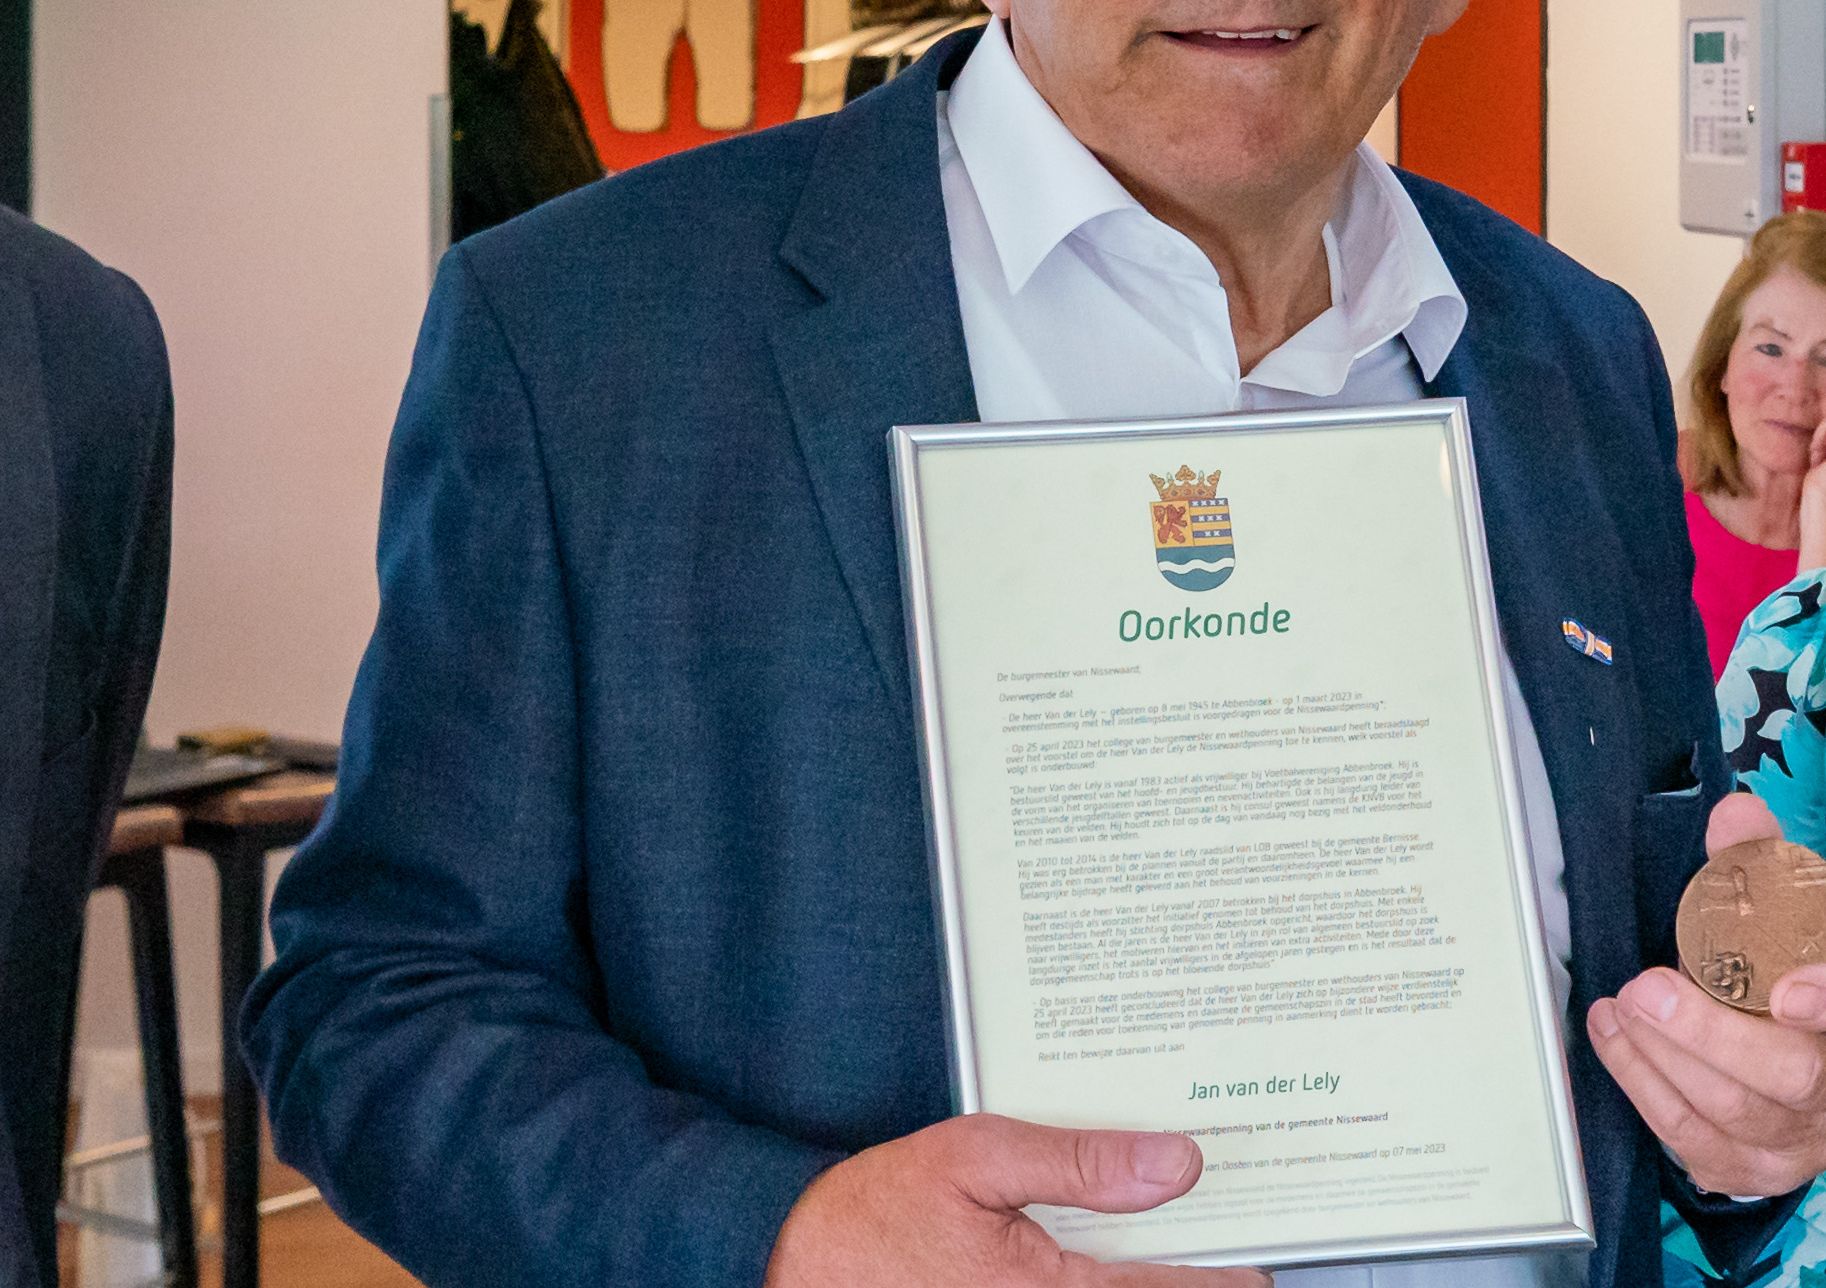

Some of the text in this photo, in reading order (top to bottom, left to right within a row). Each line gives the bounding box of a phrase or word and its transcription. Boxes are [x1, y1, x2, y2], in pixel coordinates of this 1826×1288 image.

[1119, 601, 1291, 643] Oorkonde
[997, 672, 1008, 681] De
[999, 691, 1056, 702] Overwegende
[1008, 713, 1020, 721] De
[1023, 712, 1042, 720] heer
[1045, 711, 1060, 719] Van
[1063, 710, 1076, 718] der
[1080, 708, 1097, 718] Lely
[1110, 706, 1145, 717] geboren
[1148, 705, 1158, 714] op
[1162, 703, 1167, 712] 8
[1189, 700, 1208, 710] 1945
[1222, 697, 1272, 707] Abbenbroek
[1282, 697, 1293, 706] op
[1303, 694, 1327, 702] maart
[1330, 691, 1351, 701] 2023
[1082, 717, 1098, 726] met
[1101, 716, 1115, 725] het
[1284, 705, 1294, 714] de
[1012, 743, 1023, 753] Op
[1027, 742, 1037, 751] 25
[1040, 742, 1059, 751] april
[1062, 740, 1083, 749] 2023
[1087, 739, 1100, 747] het
[1103, 738, 1133, 747] college
[1228, 728, 1278, 738] wethouders
[1298, 723, 1346, 733] Nissewaard
[1349, 721, 1370, 730] heeft
[1027, 753, 1040, 761] het
[1044, 751, 1077, 760] voorstel
[1096, 749, 1107, 757] de
[1110, 746, 1128, 756] heer
[1131, 747, 1147, 755] Van
[1150, 746, 1164, 754] der
[1167, 743, 1184, 754] Lely
[1285, 737, 1298, 745] toe
[1302, 736, 1309, 744] te
[1348, 732, 1366, 741] welk
[1369, 729, 1402, 739] voorstel
[1405, 729, 1417, 737] als
[1006, 764, 1028, 775] volgt
[1027, 785, 1046, 793] heer
[1049, 783, 1065, 791] Van
[1068, 782, 1081, 790] der
[1085, 781, 1102, 790] Lely
[1114, 778, 1137, 787] vanaf
[1141, 776, 1161, 785] 1983
[1164, 774, 1188, 784] actief
[1191, 774, 1202, 782] als
[1251, 770, 1261, 780] bij
[1398, 760, 1409, 770] Hij
[1017, 859, 1033, 868] Van
[1036, 857, 1057, 866] 2010
[1060, 856, 1072, 864] tot
[1076, 854, 1096, 864] 2014
[1110, 853, 1119, 861] de
[1122, 852, 1141, 860] heer
[1163, 849, 1176, 858] der
[1180, 848, 1197, 857] Lely
[1200, 844, 1233, 855] raadslid
[1254, 842, 1270, 851] LOB
[1274, 839, 1308, 852] geweest
[1311, 839, 1322, 849] bij
[1324, 838, 1335, 847] de
[1338, 835, 1380, 848] gemeente
[1040, 997, 1051, 1007] Op
[1055, 997, 1076, 1005] basis
[1098, 994, 1118, 1002] deze
[1186, 986, 1200, 995] het
[1204, 985, 1234, 994] college
[1331, 973, 1381, 984] wethouders
[1402, 967, 1451, 978] Nissewaard
[1453, 968, 1464, 977] op
[1188, 1071, 1340, 1100] Jan van der Lely
[1255, 1123, 1271, 1131] van
[1274, 1120, 1285, 1129] de
[1288, 1116, 1334, 1130] gemeente
[1336, 1111, 1388, 1124] Nissewaard
[1222, 1160, 1252, 1170] Oosten
[1254, 1159, 1269, 1167] van
[1272, 1157, 1282, 1166] de
[1284, 1153, 1327, 1167] gemeente
[1329, 1148, 1377, 1161] Nissewaard
[1379, 1149, 1390, 1159] op
[1392, 1145, 1404, 1156] 07
[1423, 1142, 1445, 1153] 2023
